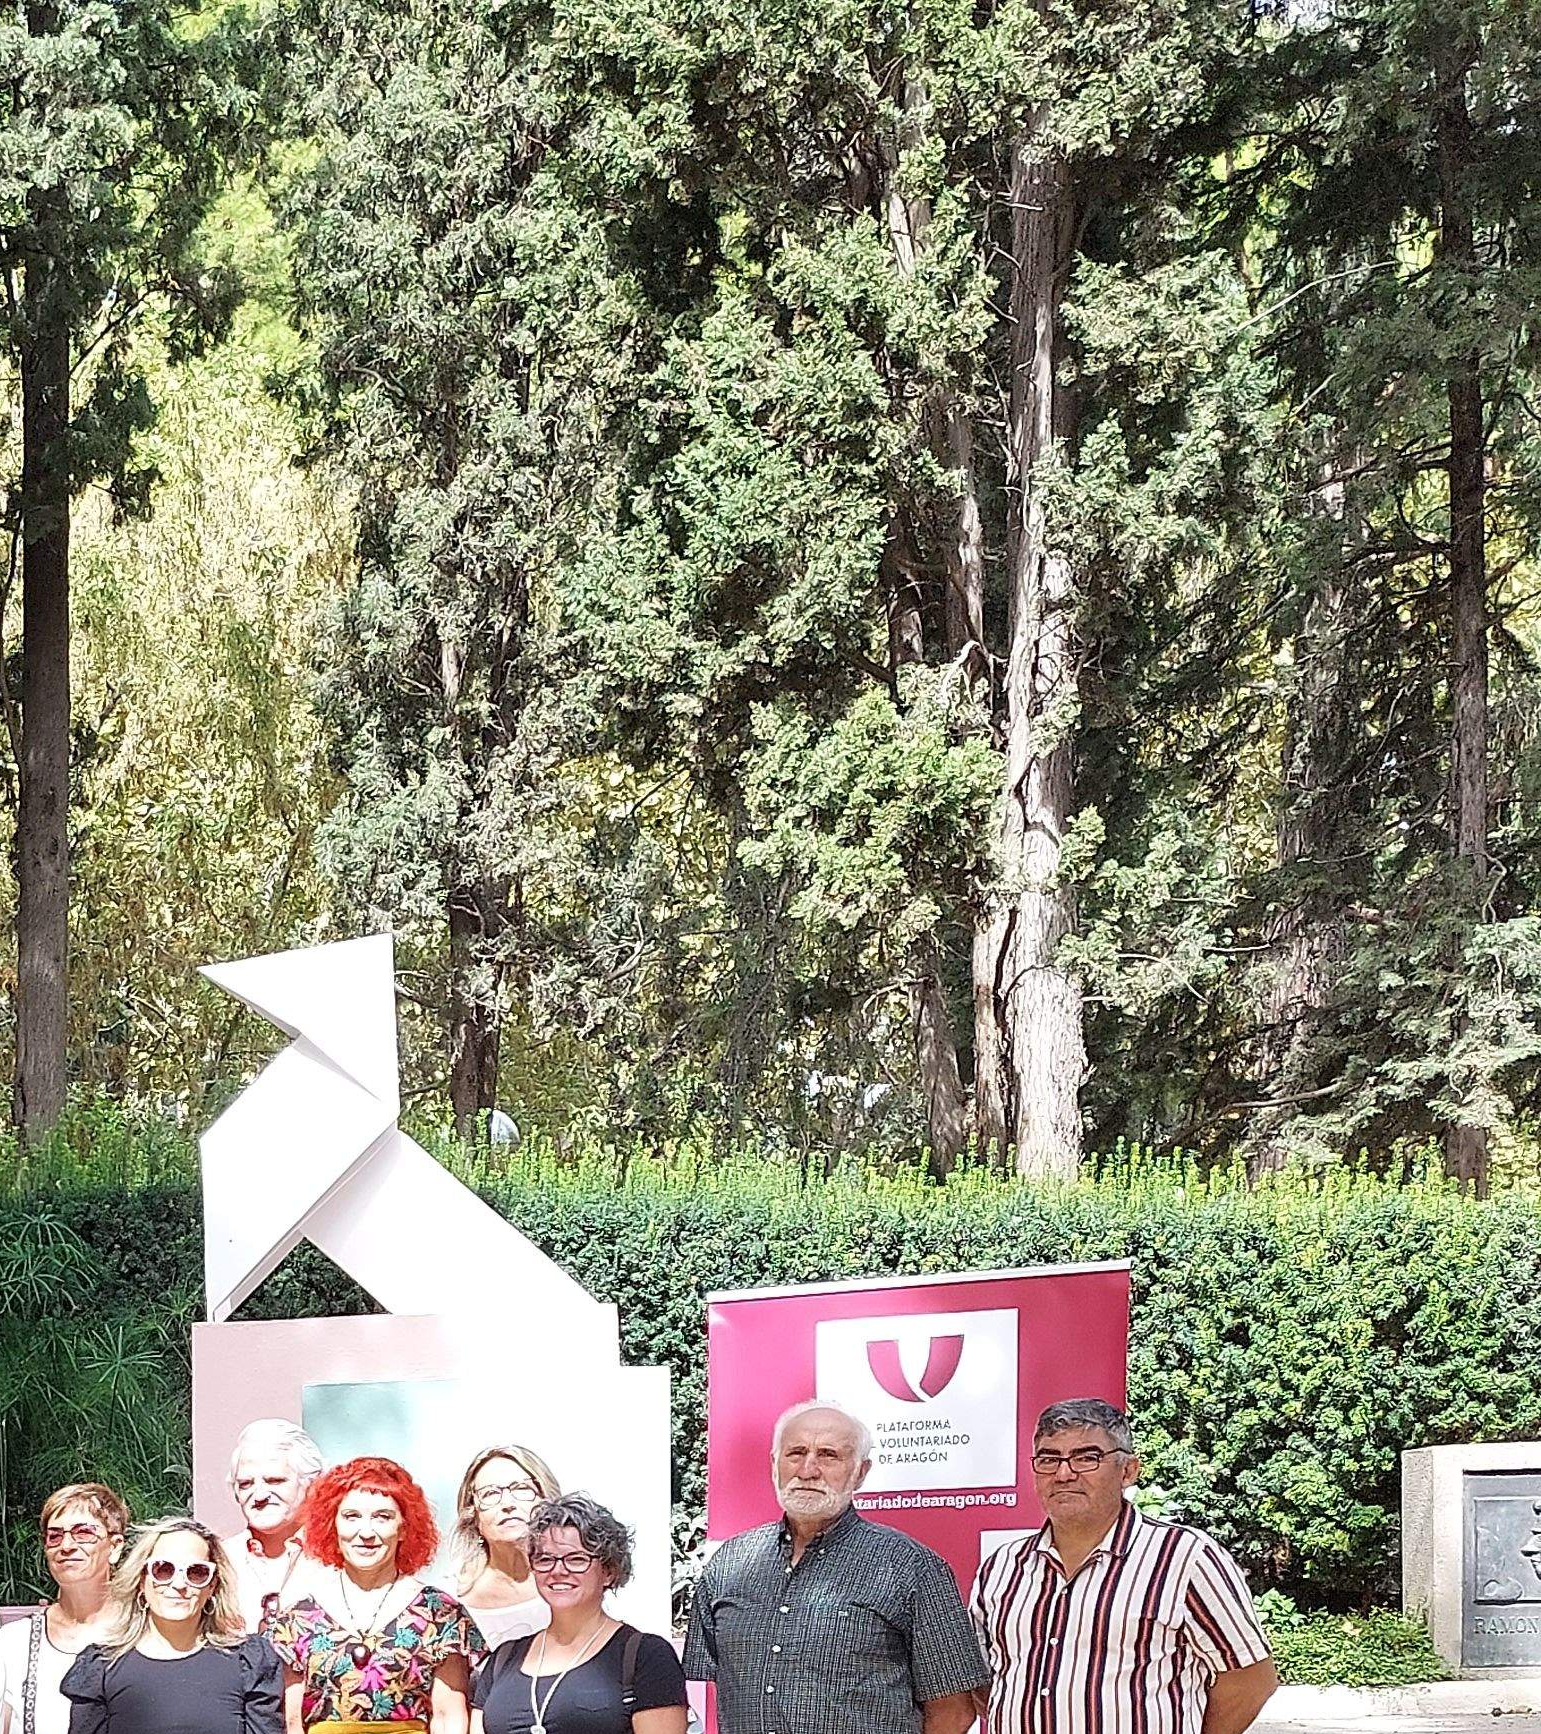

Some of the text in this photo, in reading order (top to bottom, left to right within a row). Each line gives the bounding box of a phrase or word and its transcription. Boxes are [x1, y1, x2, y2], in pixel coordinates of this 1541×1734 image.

[877, 1419, 951, 1433] PLATAFORMA
[880, 1434, 970, 1448] VOLUNTARIADO
[879, 1449, 947, 1464] DE ARAGÓN
